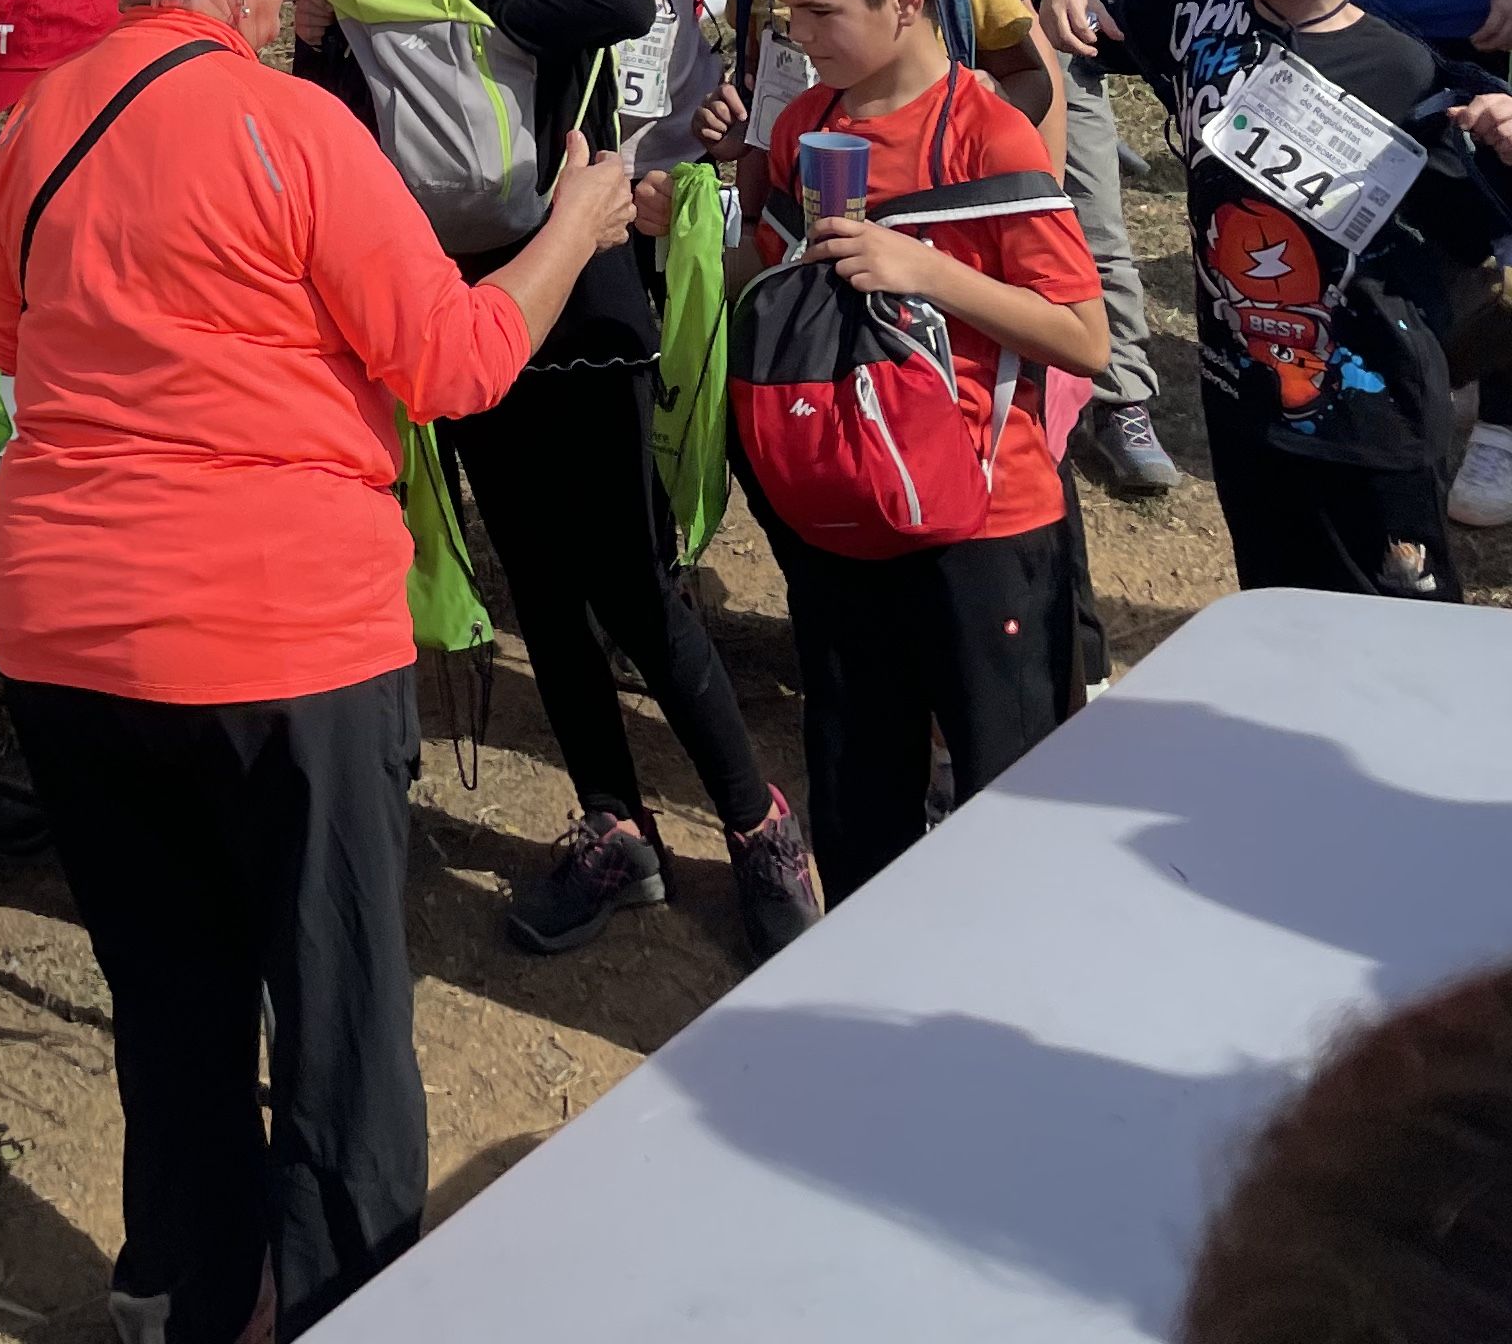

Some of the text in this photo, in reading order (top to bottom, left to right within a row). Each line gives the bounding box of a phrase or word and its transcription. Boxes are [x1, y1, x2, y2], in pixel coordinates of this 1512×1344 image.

[1192, 37, 1242, 86] THE
[1234, 126, 1338, 210] 124
[1249, 315, 1306, 339] BEST
